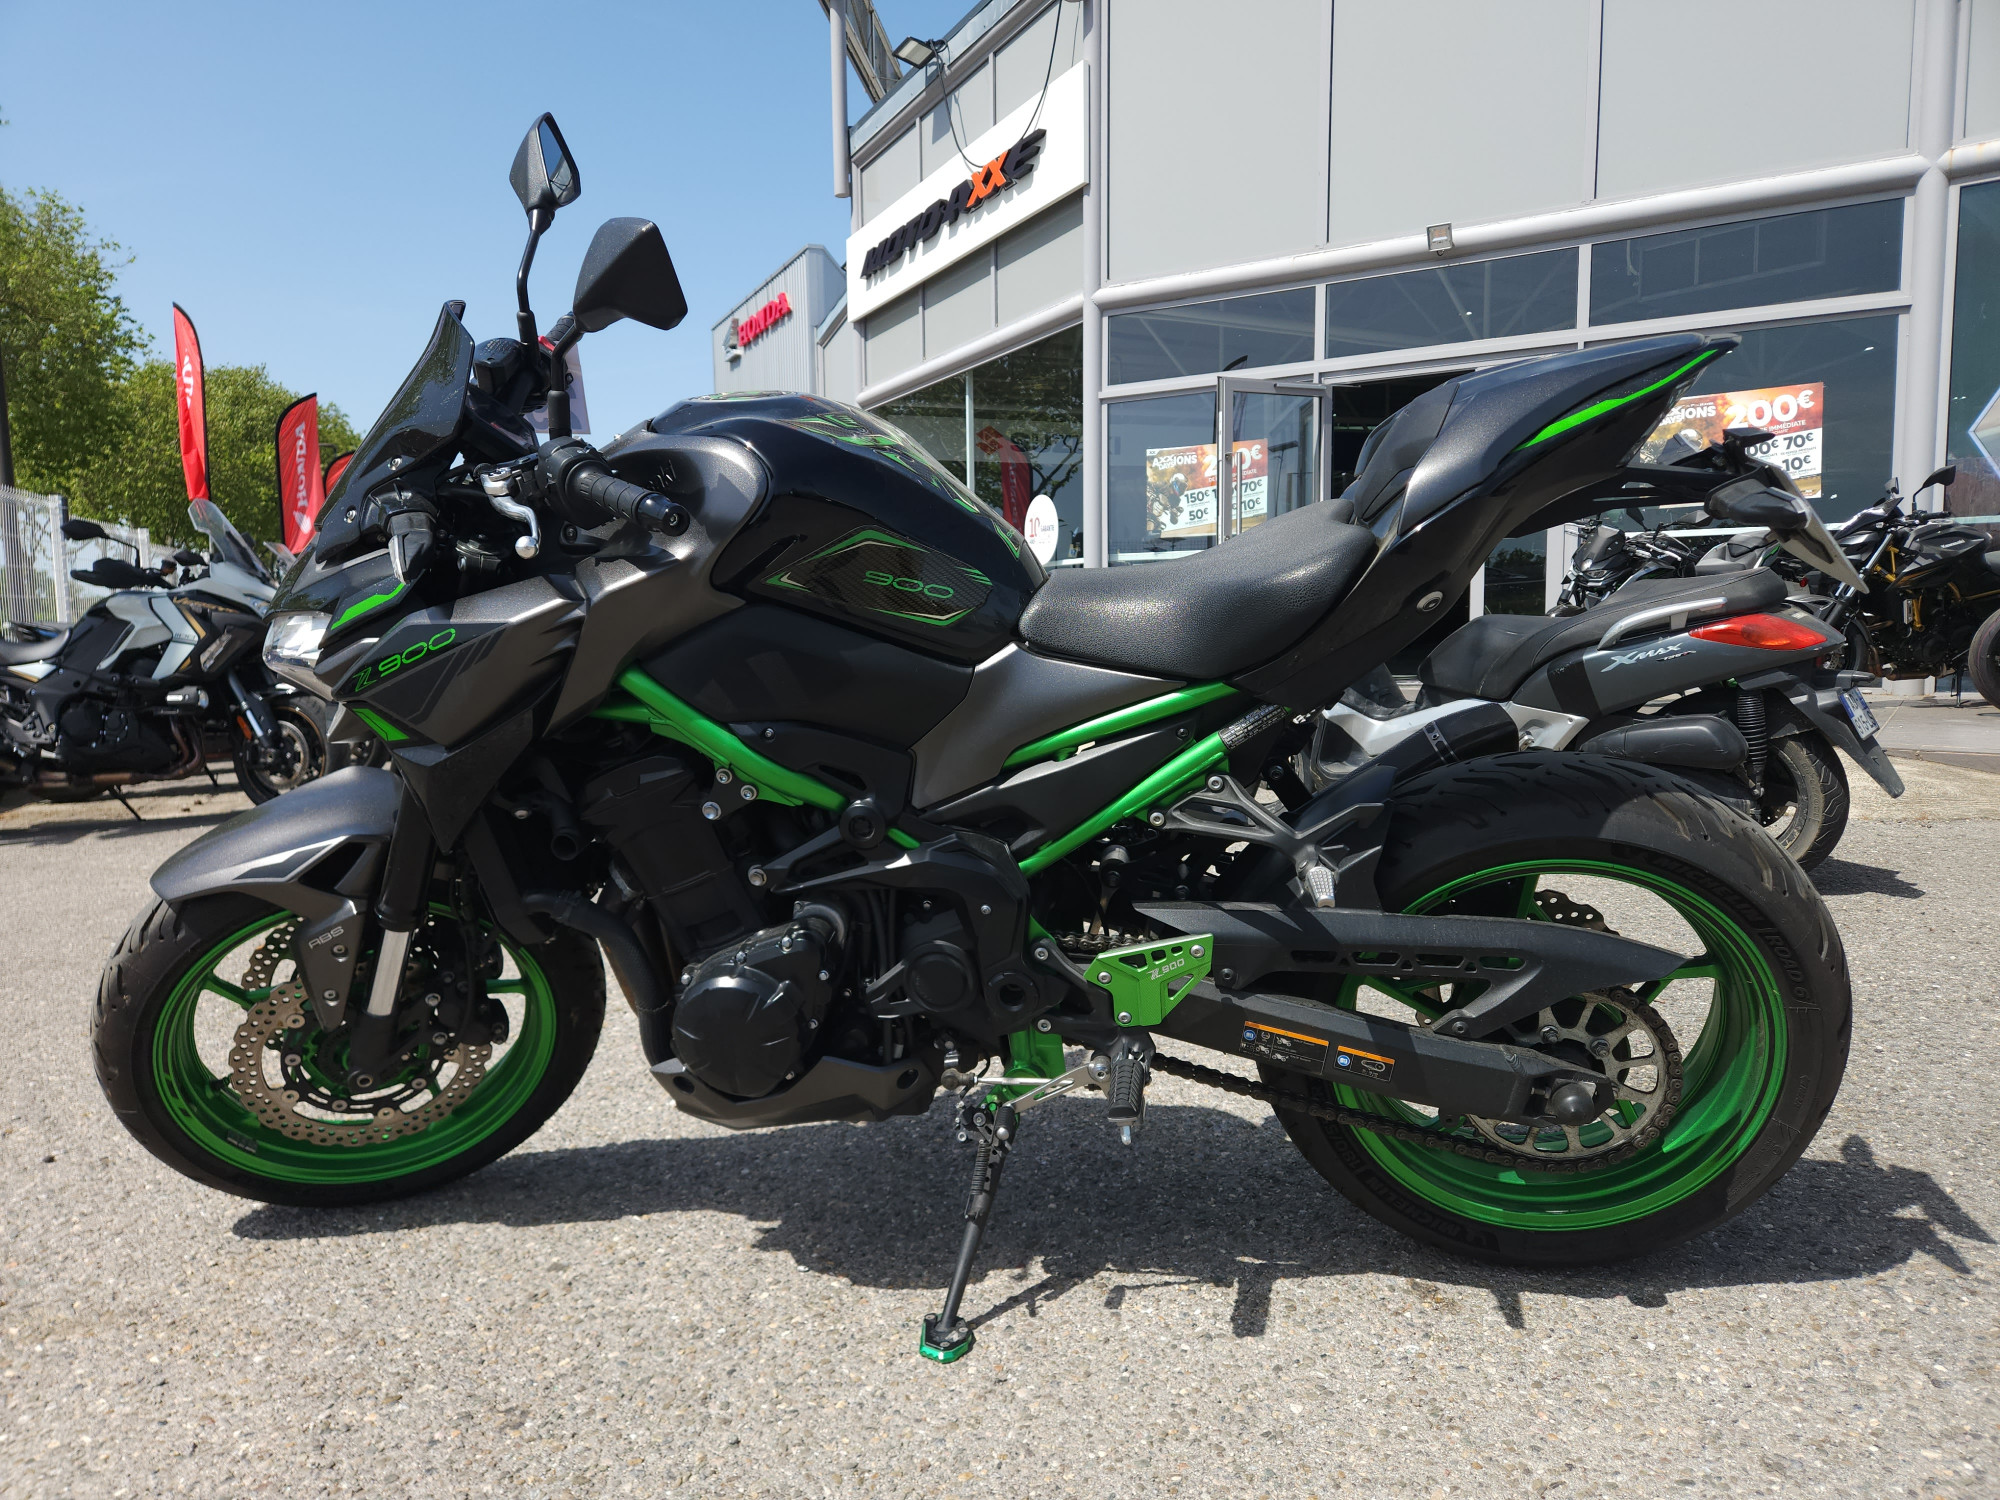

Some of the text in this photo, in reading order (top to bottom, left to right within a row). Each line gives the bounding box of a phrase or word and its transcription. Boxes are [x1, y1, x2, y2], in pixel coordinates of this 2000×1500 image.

[737, 292, 792, 347] HONDA
[1724, 389, 1815, 429] 200€
[1747, 439, 1779, 456] 00€
[1783, 432, 1814, 450] 70€
[295, 421, 309, 507] HONDA
[1782, 455, 1811, 472] 10€
[1184, 489, 1210, 504] 150€
[1188, 507, 1209, 521] 50€
[863, 570, 954, 599] 900
[308, 926, 344, 949] ABS
[1764, 933, 1806, 985] ROAD
